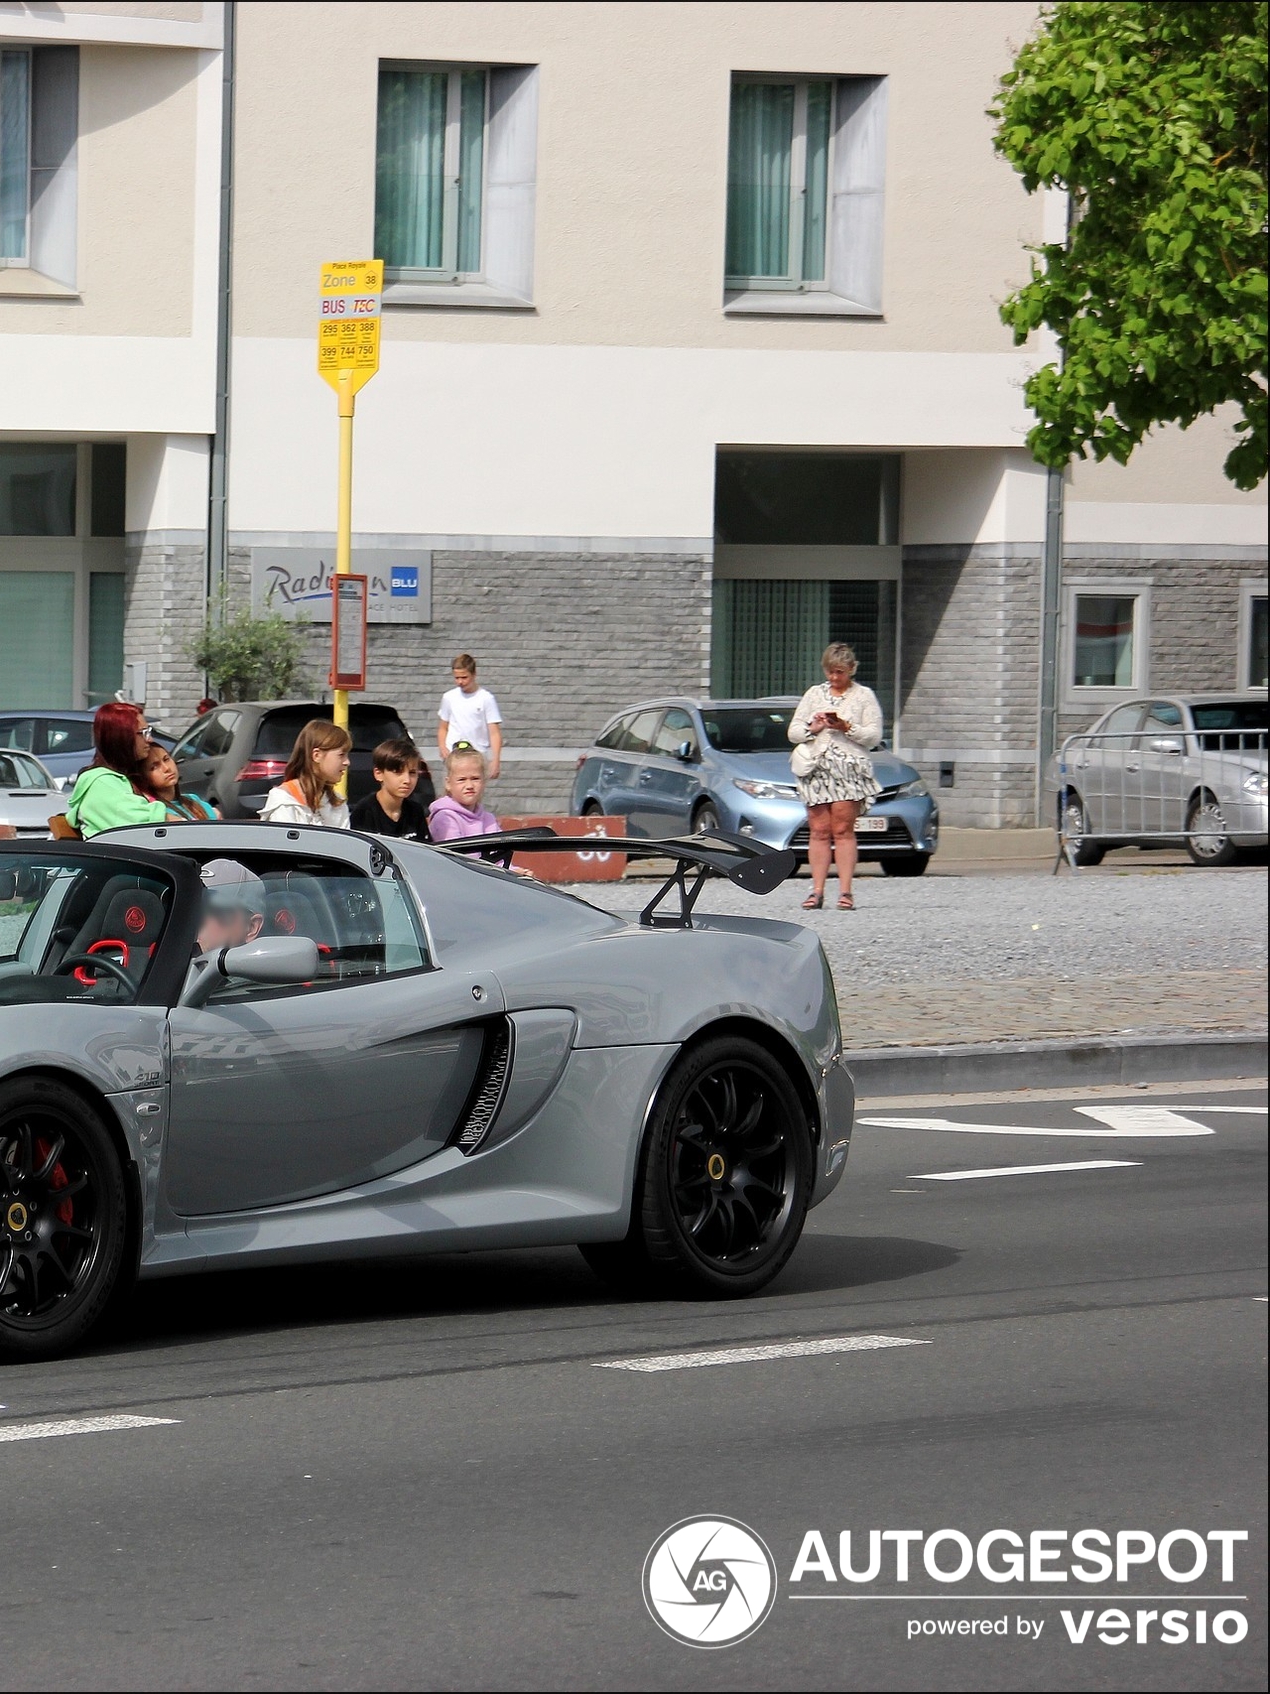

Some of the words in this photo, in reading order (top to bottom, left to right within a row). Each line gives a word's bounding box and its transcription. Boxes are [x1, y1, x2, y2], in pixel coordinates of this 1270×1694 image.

[323, 274, 356, 288] Zone
[365, 275, 376, 285] 38
[322, 299, 346, 314] BUS
[353, 299, 375, 313] TEC
[323, 324, 338, 334] 295
[341, 323, 356, 333] 362
[359, 322, 375, 332] 388
[321, 347, 337, 357] 399
[340, 346, 355, 356] 744
[358, 345, 374, 355] 750
[265, 560, 388, 605] Radin
[391, 578, 418, 589] BLU
[389, 603, 419, 612] HOTEL
